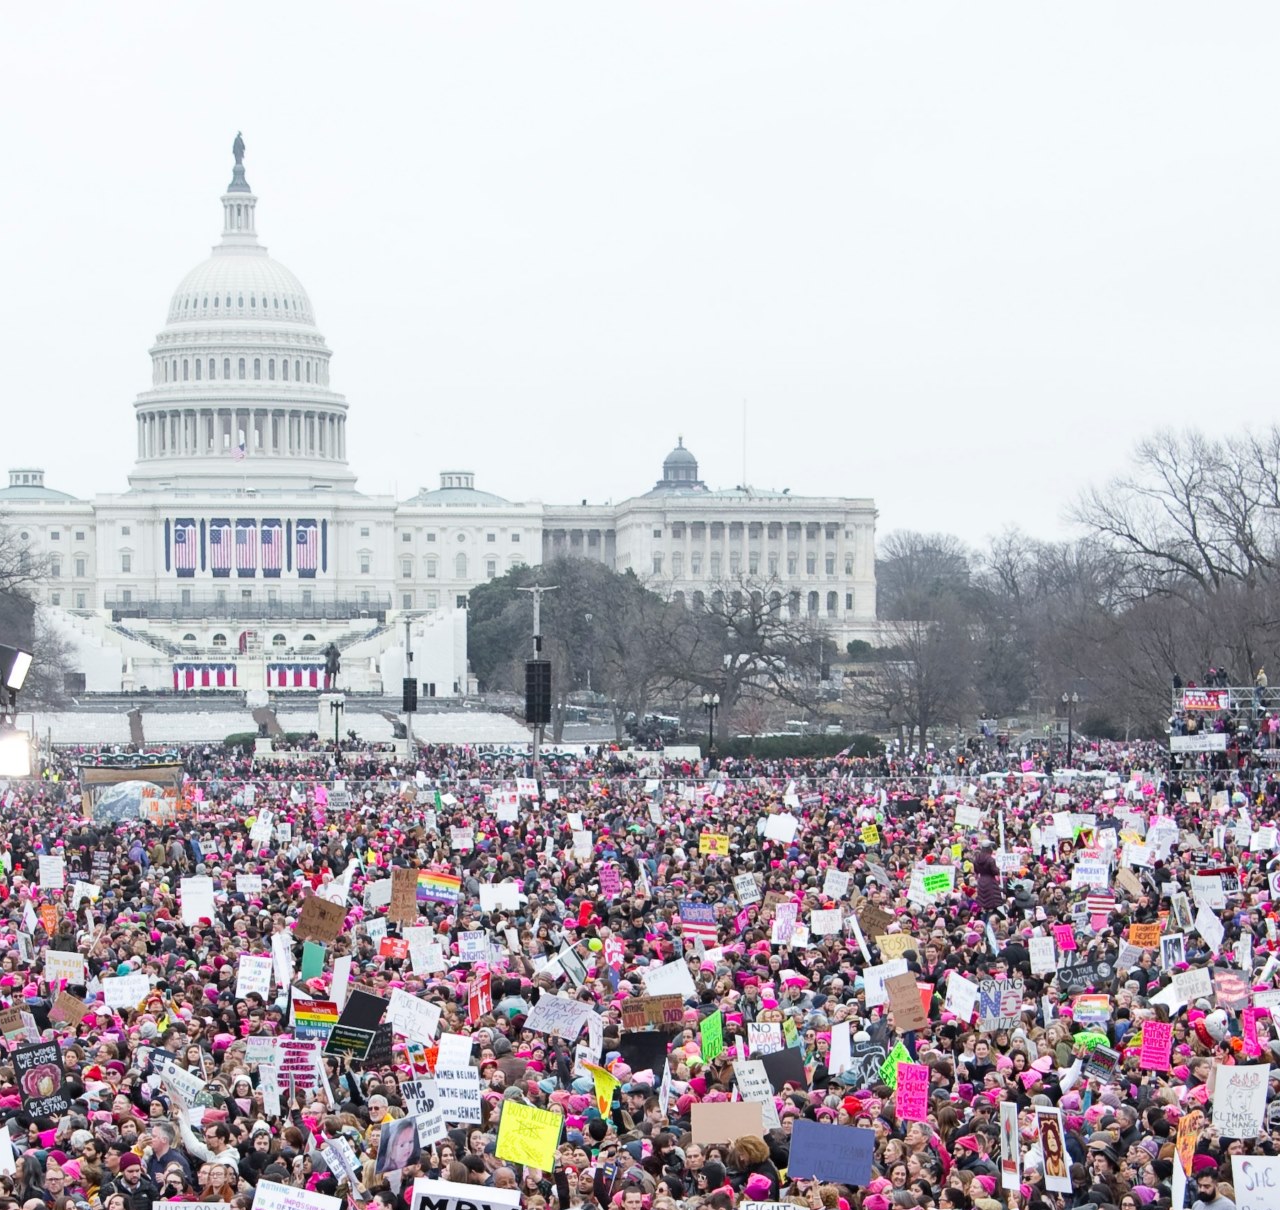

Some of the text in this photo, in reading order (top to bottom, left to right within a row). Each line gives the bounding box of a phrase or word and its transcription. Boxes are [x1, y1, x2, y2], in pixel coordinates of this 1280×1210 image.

[16, 1045, 56, 1061] FROM WOMEN
[18, 1053, 57, 1069] WE COME
[29, 1101, 67, 1117] WE STAND
[30, 1095, 62, 1109] BY WOMEN
